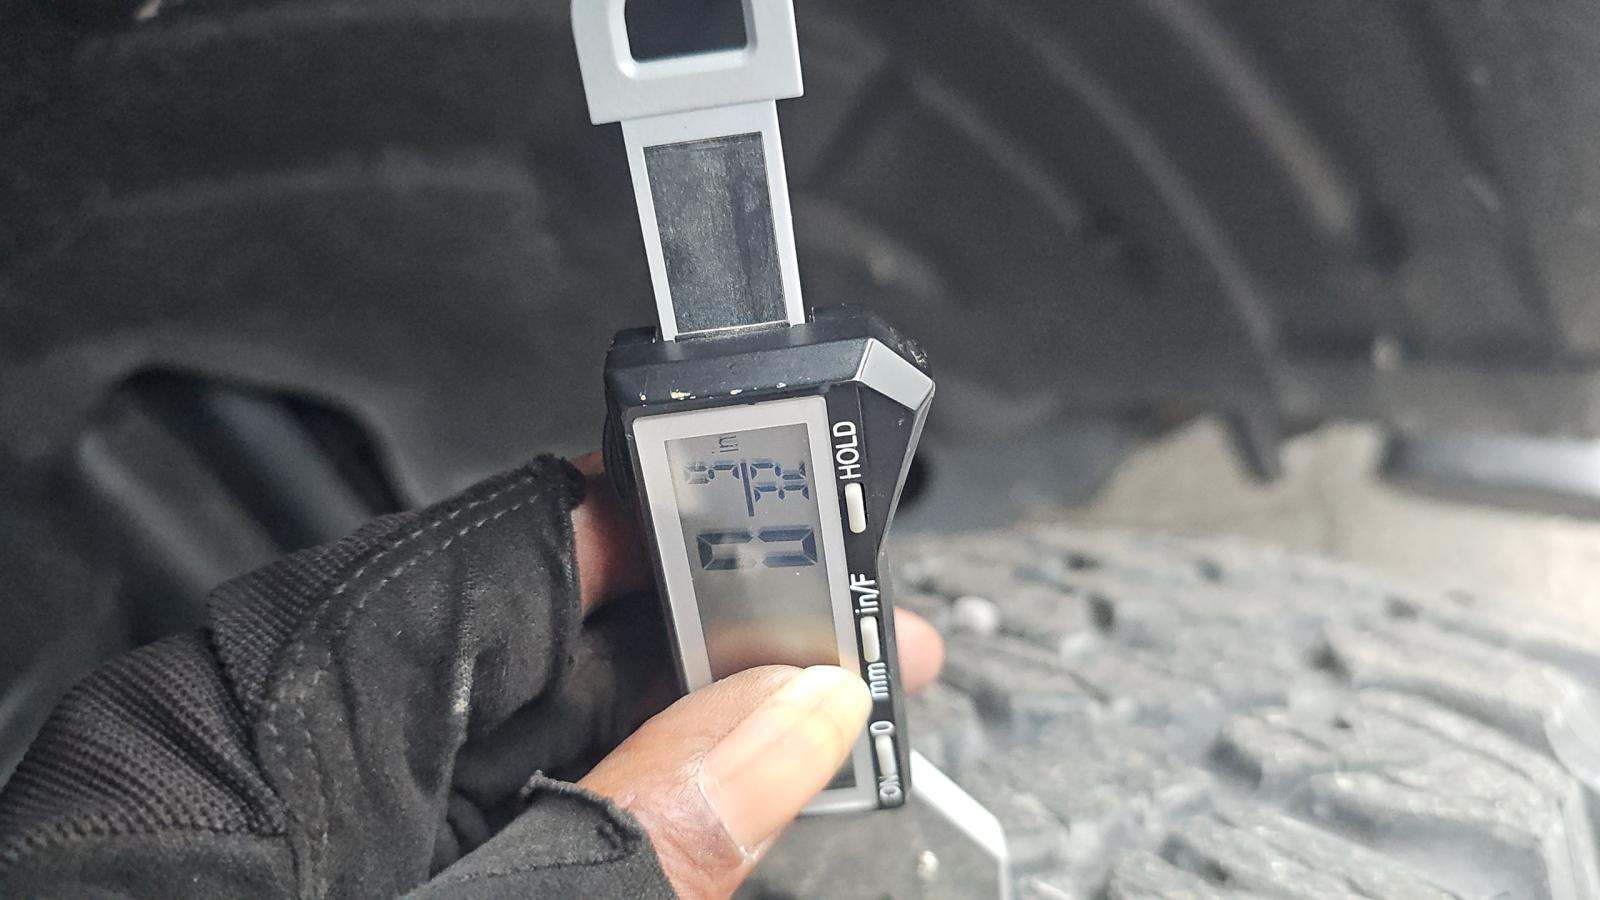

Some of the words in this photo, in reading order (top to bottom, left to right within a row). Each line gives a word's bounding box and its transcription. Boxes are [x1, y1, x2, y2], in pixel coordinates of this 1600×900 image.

[711, 434, 738, 454] in
[832, 421, 862, 481] HOLD
[850, 573, 880, 615] in/F
[868, 662, 890, 700] mm
